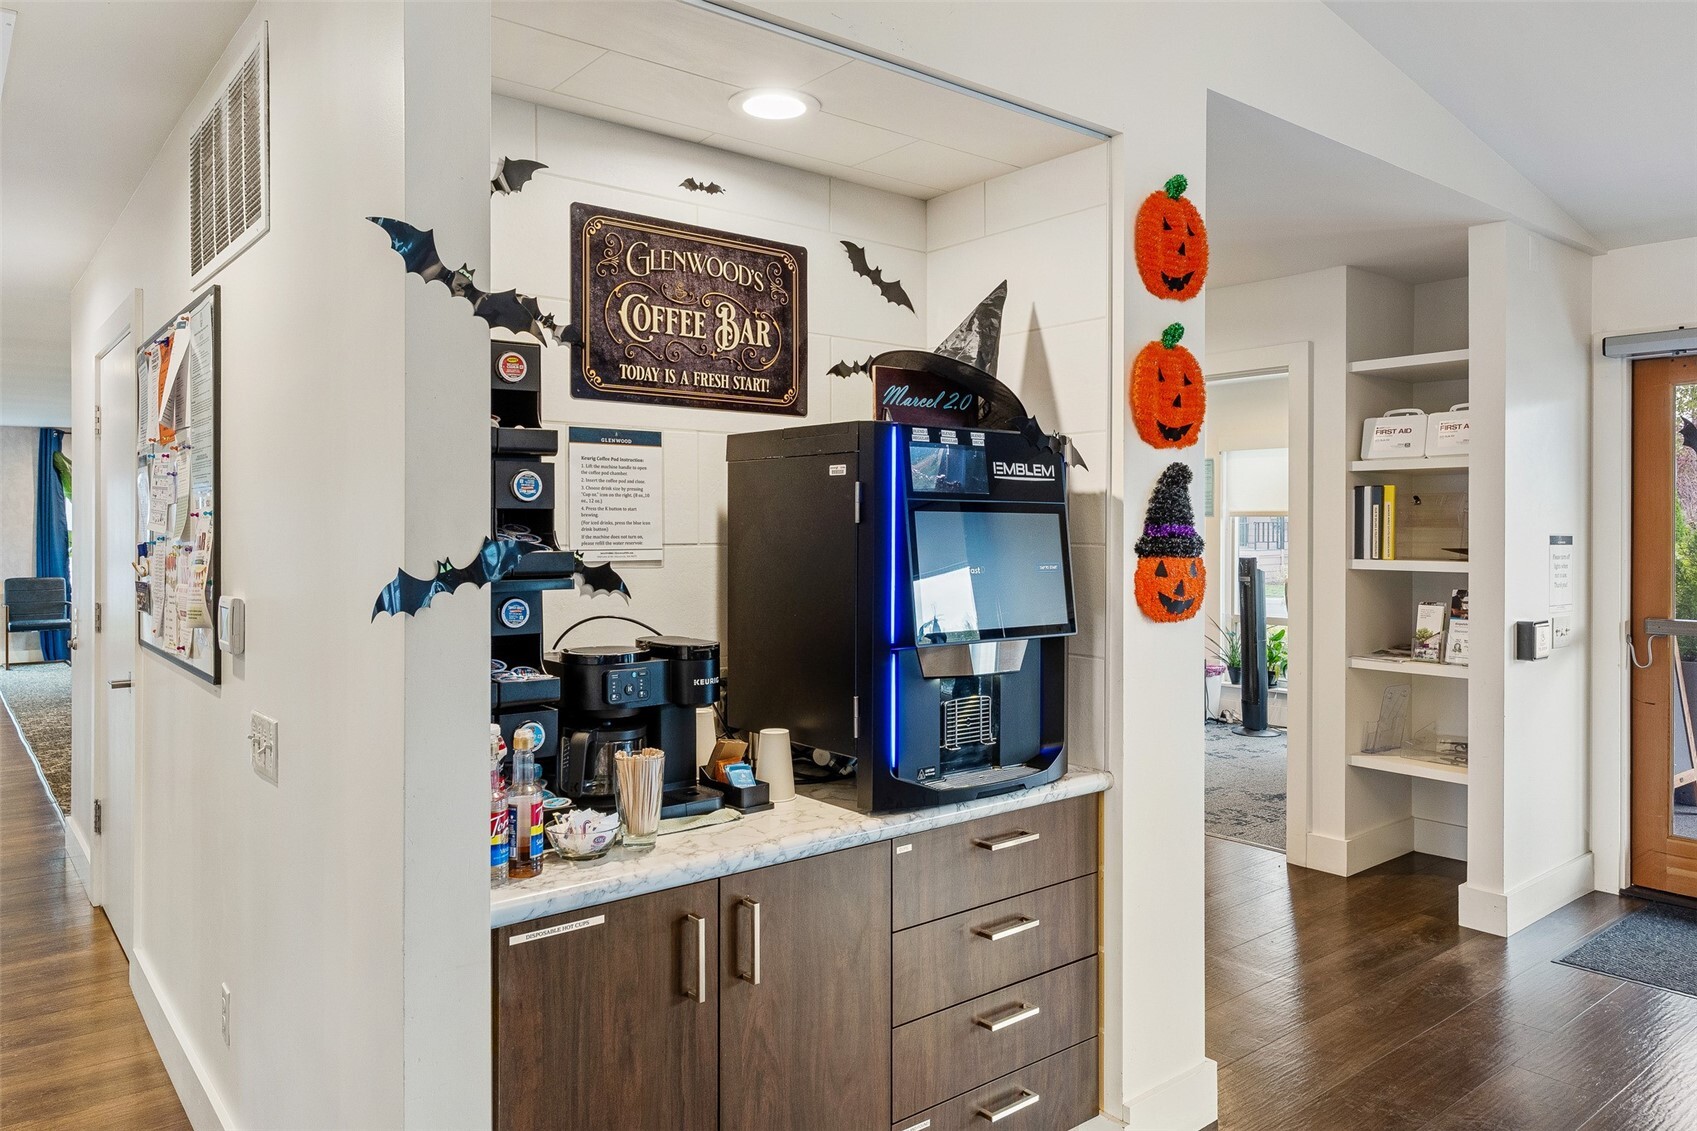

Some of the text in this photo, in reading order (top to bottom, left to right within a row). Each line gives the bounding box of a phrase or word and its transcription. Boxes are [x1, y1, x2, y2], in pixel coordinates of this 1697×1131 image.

[626, 241, 764, 292] GLENWOOD'S
[618, 293, 771, 353] COFFEE BAR
[619, 363, 770, 393] TODAY IS A FRESH START!
[882, 385, 973, 411] Marcel 2.0
[693, 677, 719, 686] KEURIG
[525, 926, 561, 940] DISPOSABLE
[574, 920, 590, 928] CUPS
